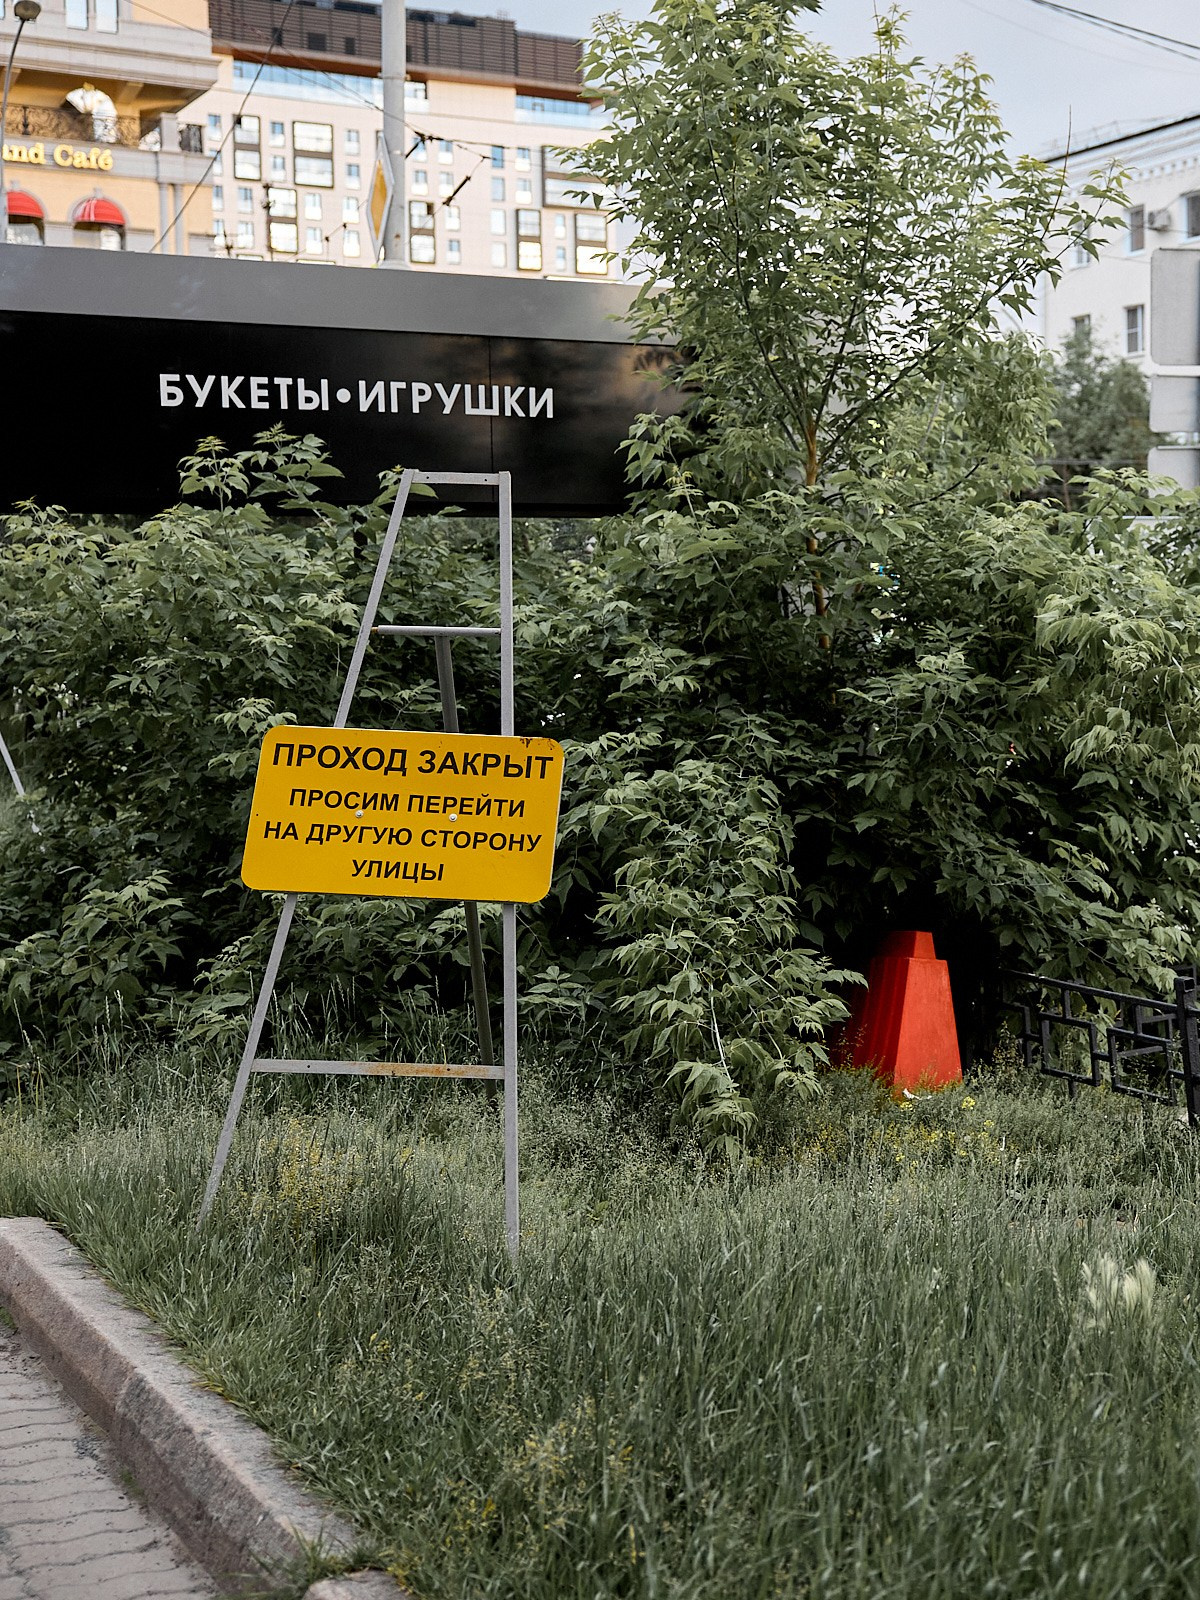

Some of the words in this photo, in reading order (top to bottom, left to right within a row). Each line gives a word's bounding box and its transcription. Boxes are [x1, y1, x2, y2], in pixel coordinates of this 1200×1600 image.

[53, 144, 114, 171] Café
[159, 373, 329, 411] БУКЕТЫ
[358, 379, 554, 419] ИГРУШКИ
[272, 743, 407, 777] ПРОХОД
[417, 750, 554, 779] ЗАКРЫТ
[289, 788, 400, 812] ПРОСИМ
[407, 793, 525, 818] ПЕРЕЙТИ
[263, 821, 299, 841] НА
[305, 823, 413, 847] ДРУГУЮ
[420, 829, 542, 853] СТОРОНУ
[351, 859, 444, 884] УЛИЦЫ
